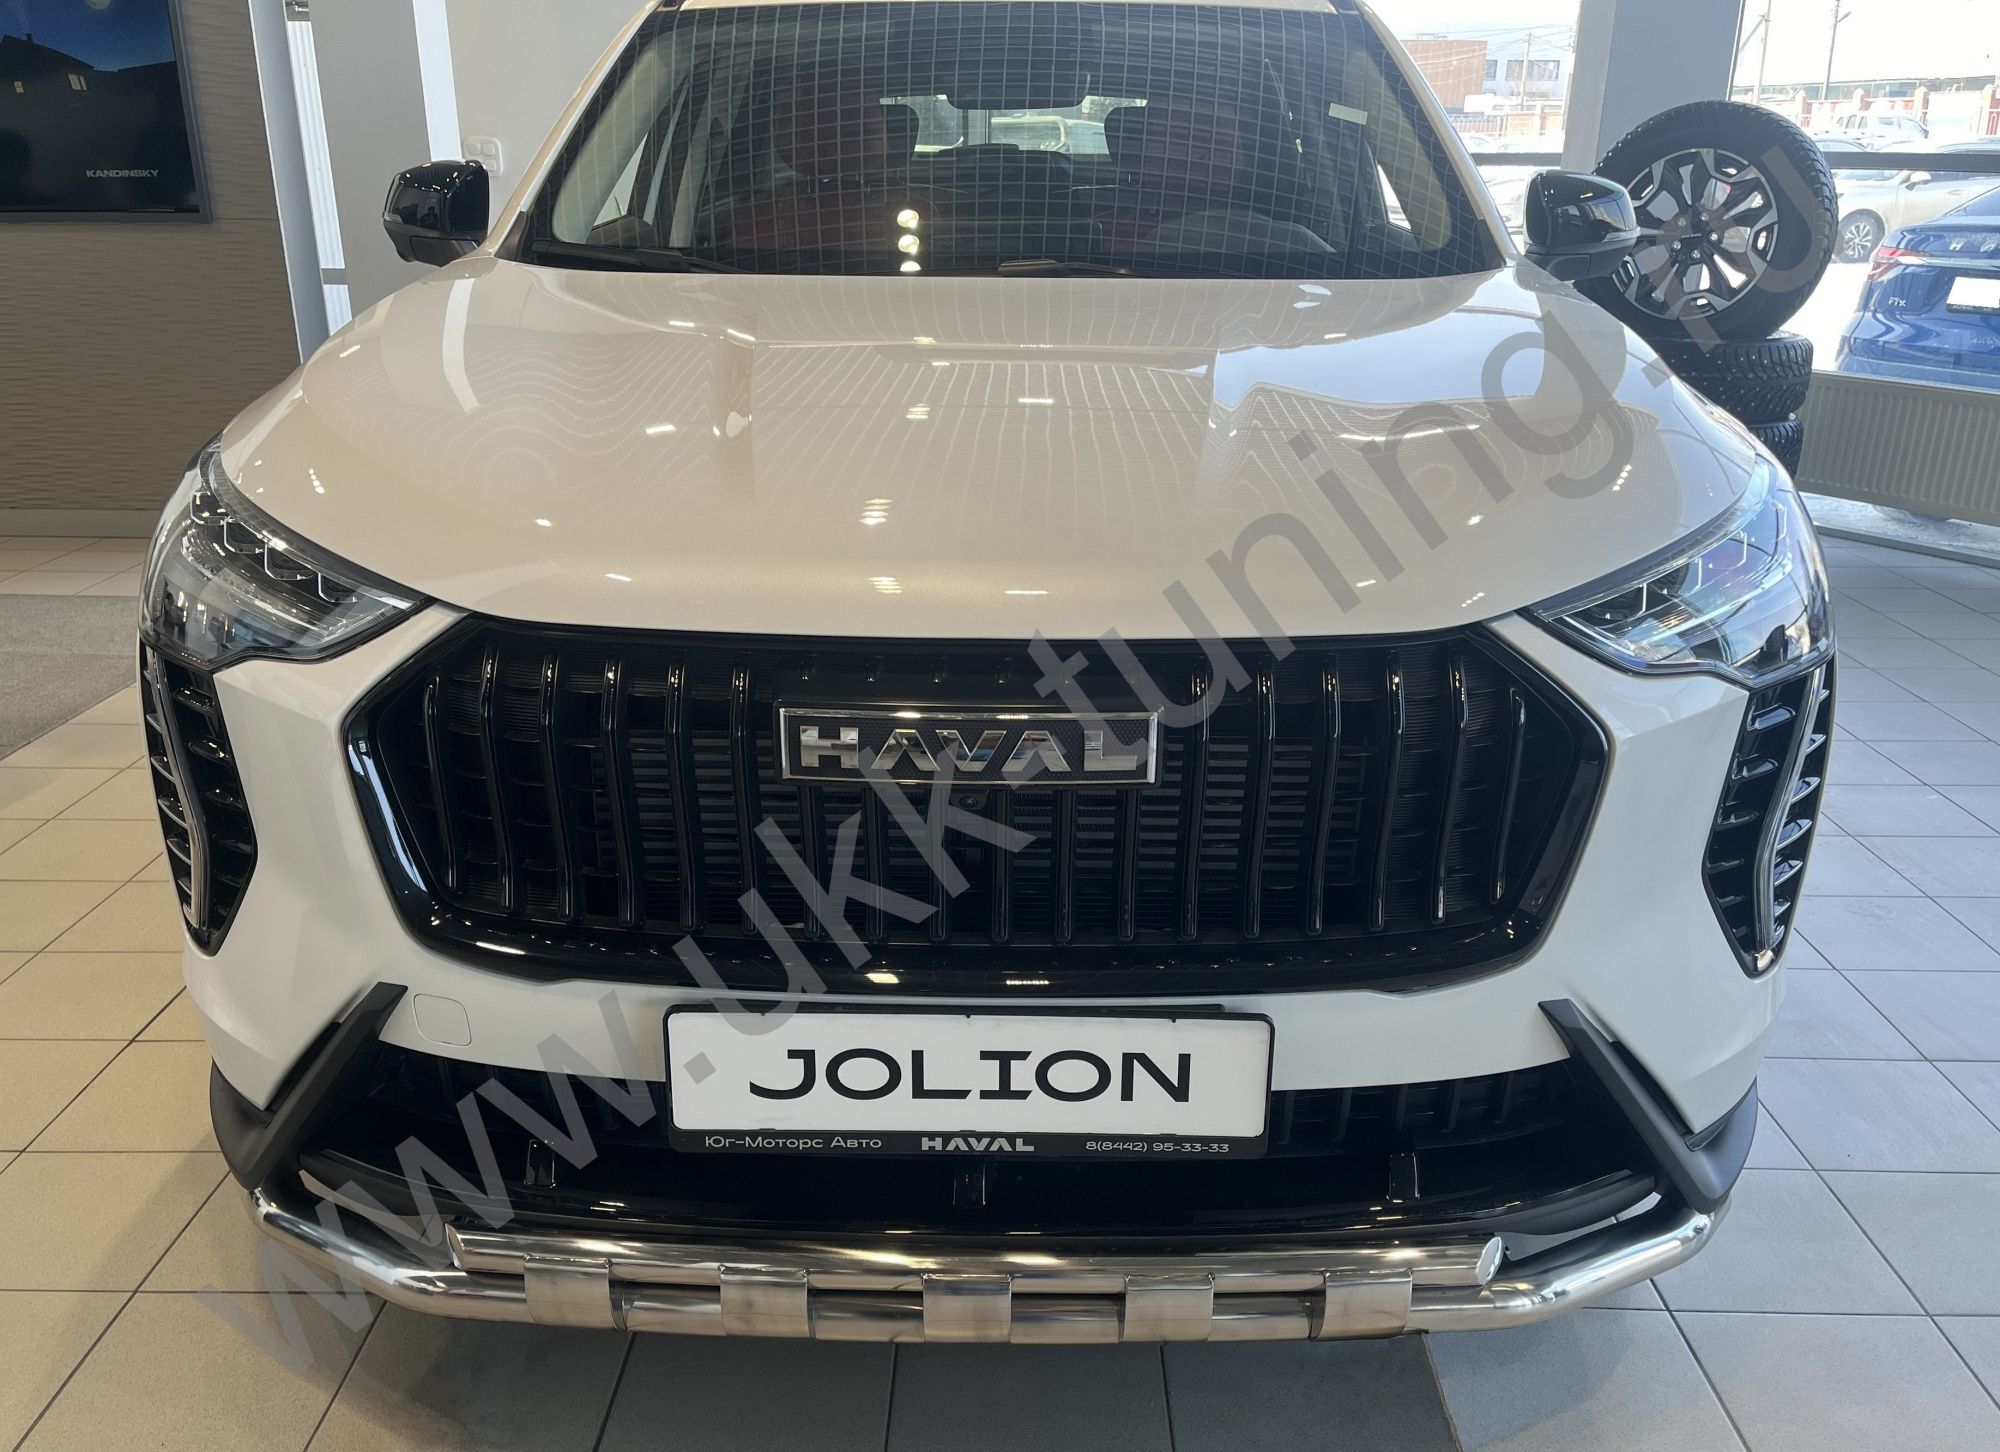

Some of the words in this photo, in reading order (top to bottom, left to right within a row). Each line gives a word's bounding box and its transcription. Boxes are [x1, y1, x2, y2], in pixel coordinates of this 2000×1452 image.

[86, 169, 159, 178] KANDINSKY
[800, 726, 1137, 771] HAVAL
[749, 1048, 1191, 1102] JOLION
[705, 1136, 823, 1150] Юг-Моторс
[830, 1136, 882, 1148] Авто
[921, 1137, 1034, 1152] HAVAL
[1085, 1141, 1148, 1153] 8(8442)
[1152, 1142, 1230, 1153] 95-33-33
